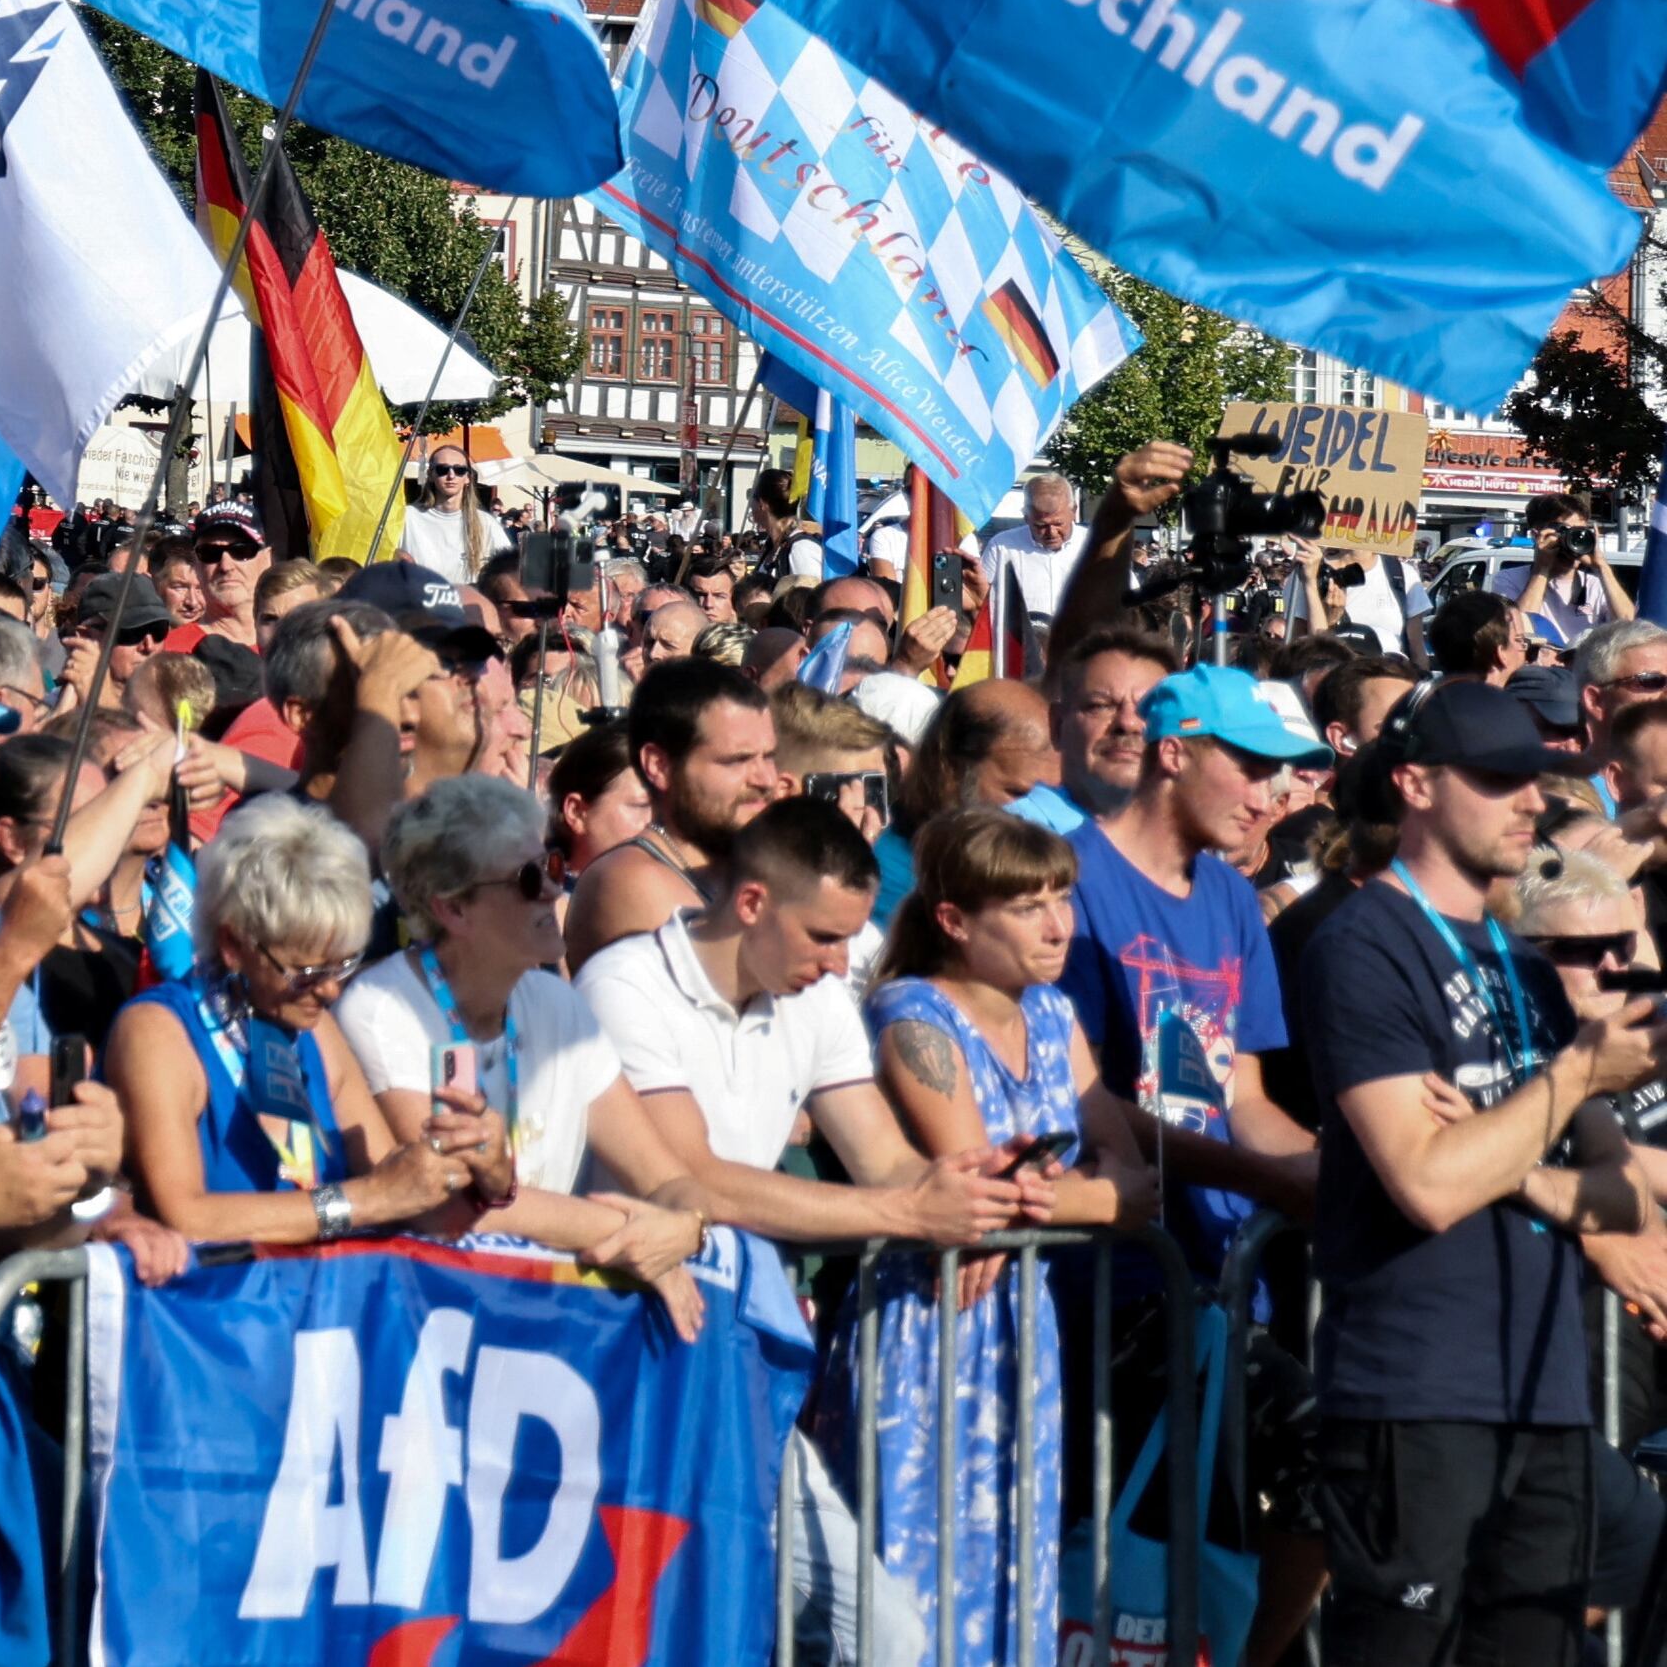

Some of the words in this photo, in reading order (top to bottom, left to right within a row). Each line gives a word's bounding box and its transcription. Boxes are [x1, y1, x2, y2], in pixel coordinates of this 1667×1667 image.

[686, 73, 990, 362] Deutschland
[730, 252, 858, 351] unterstützen
[858, 347, 917, 399] Alice
[917, 388, 984, 467] Weidel
[203, 501, 253, 517] TRUMP
[1249, 406, 1396, 472] WEIDEL
[1276, 464, 1331, 500] FÜR
[237, 1307, 600, 1625] AfD
